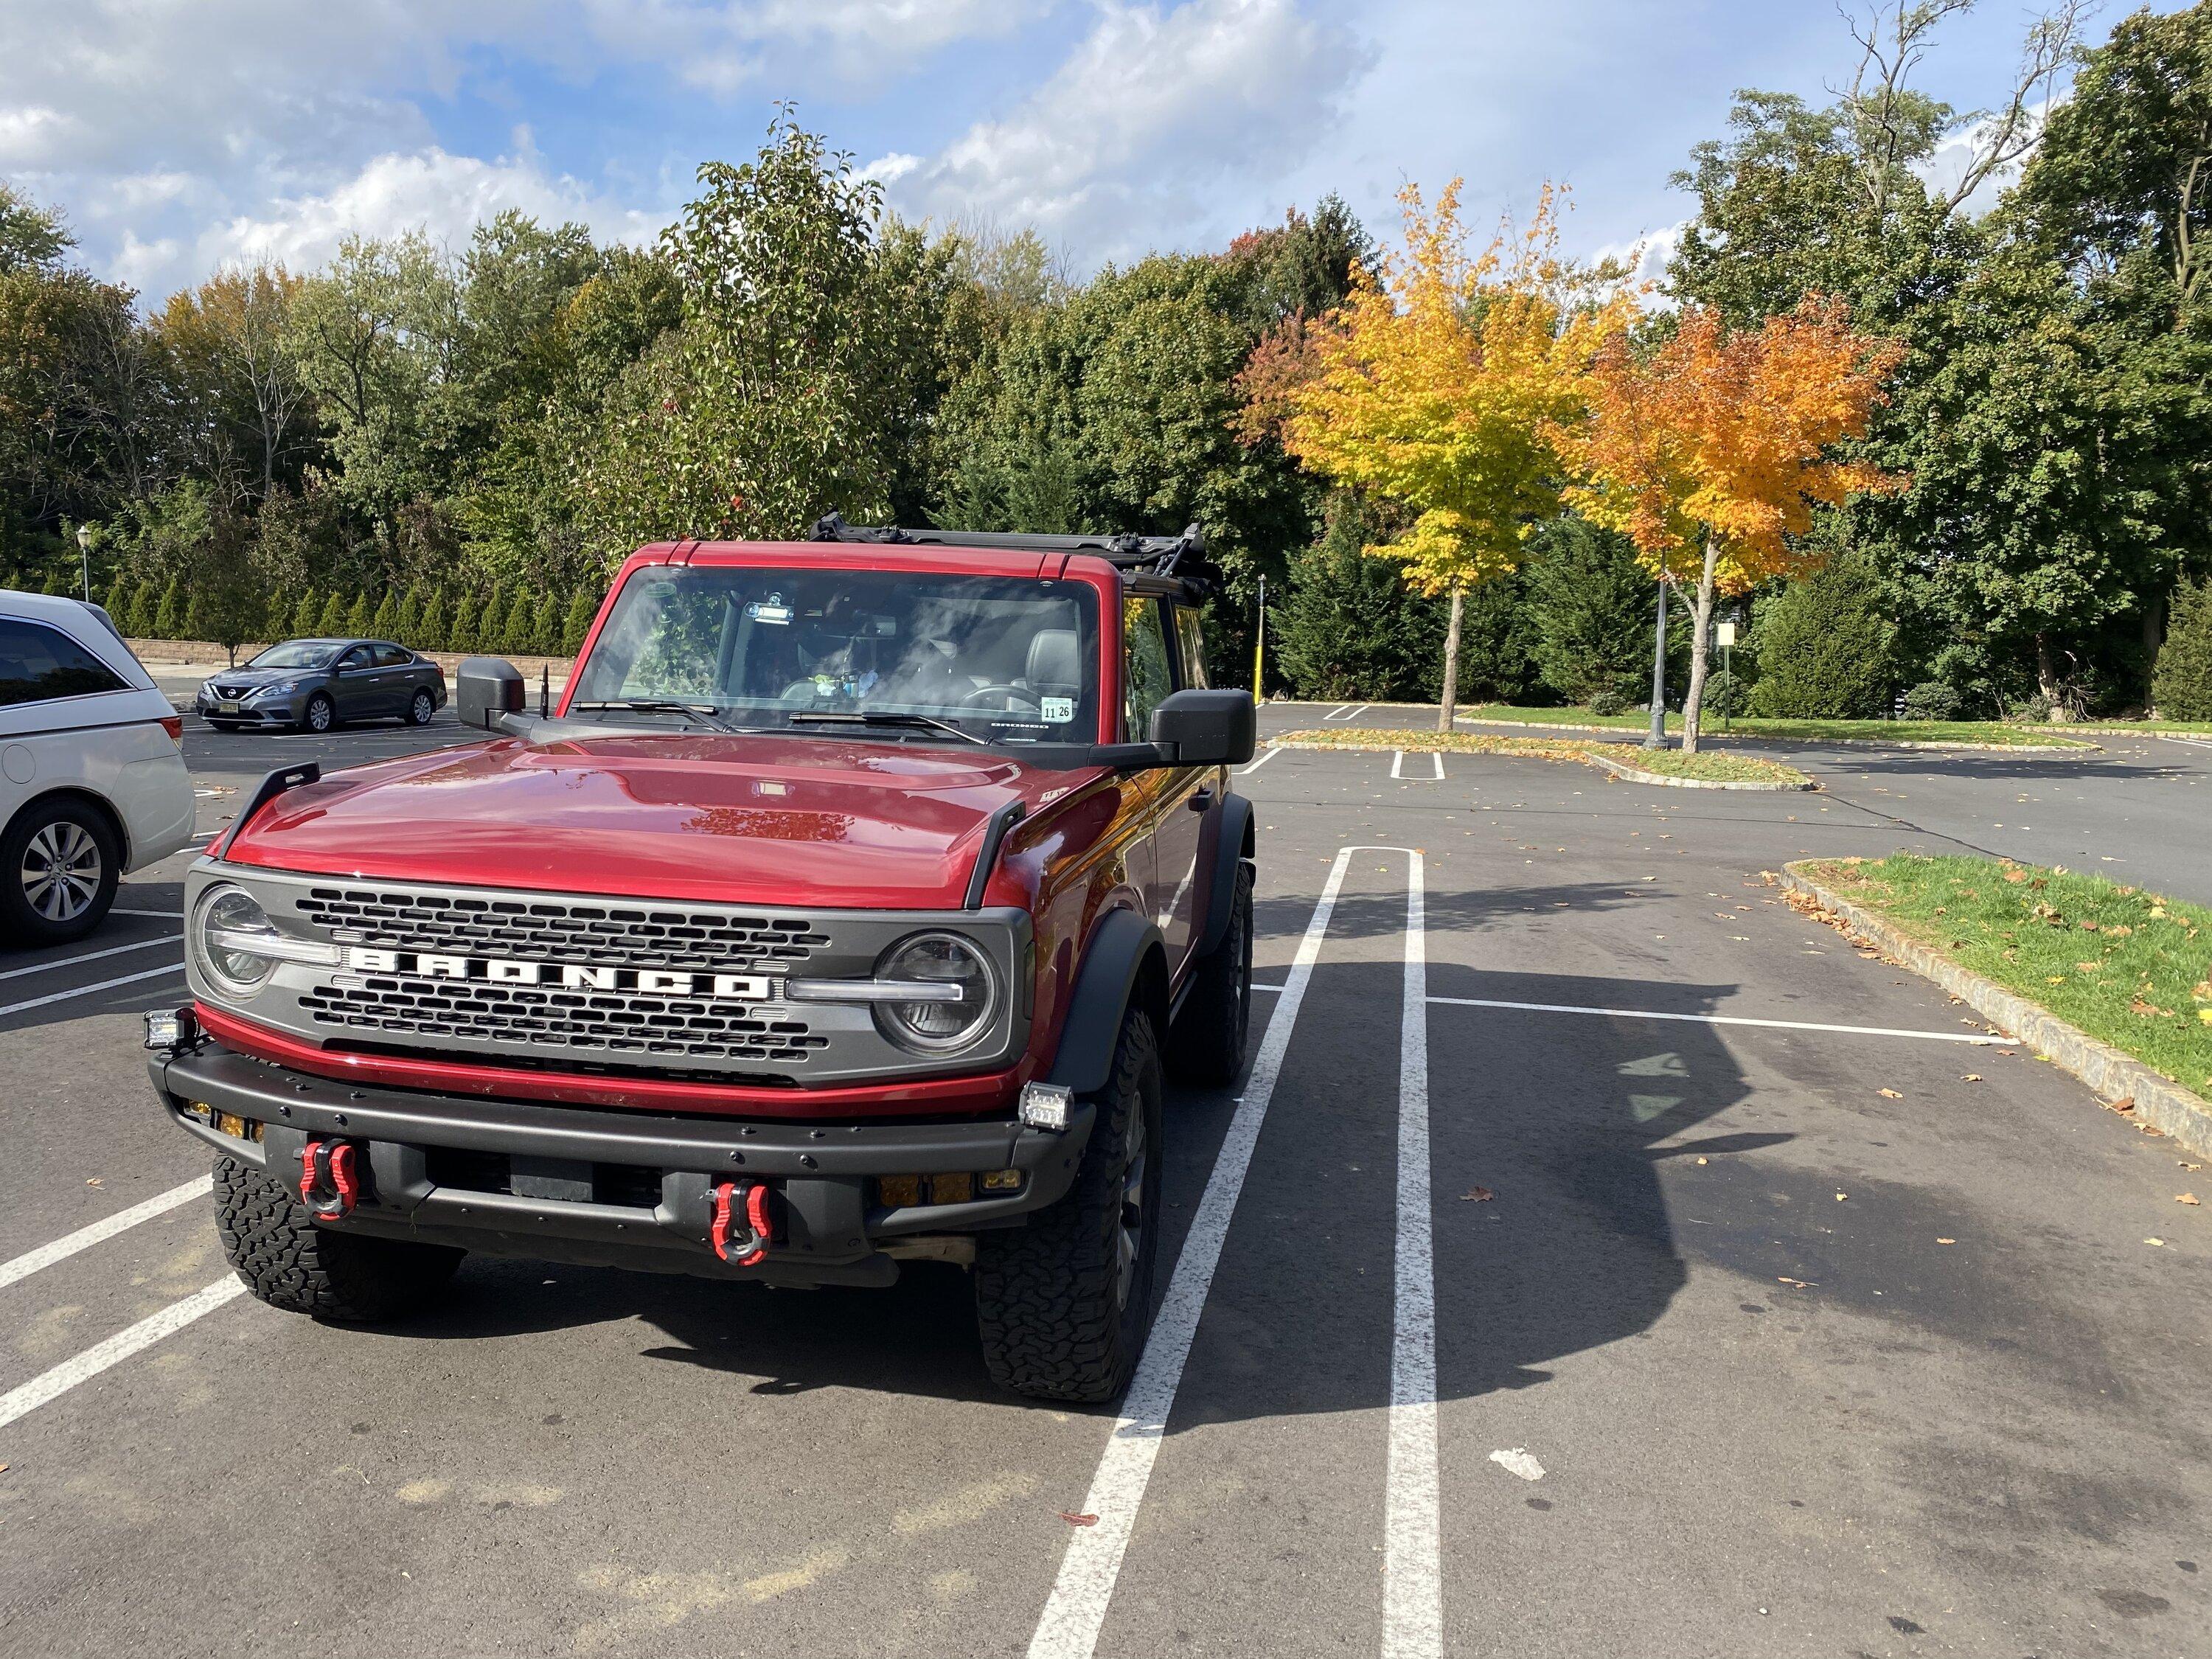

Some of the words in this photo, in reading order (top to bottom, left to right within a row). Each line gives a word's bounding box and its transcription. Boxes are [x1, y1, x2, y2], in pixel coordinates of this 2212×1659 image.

[1045, 707, 1055, 718] 11
[1059, 706, 1069, 717] 26
[349, 947, 771, 998] BRONCO
